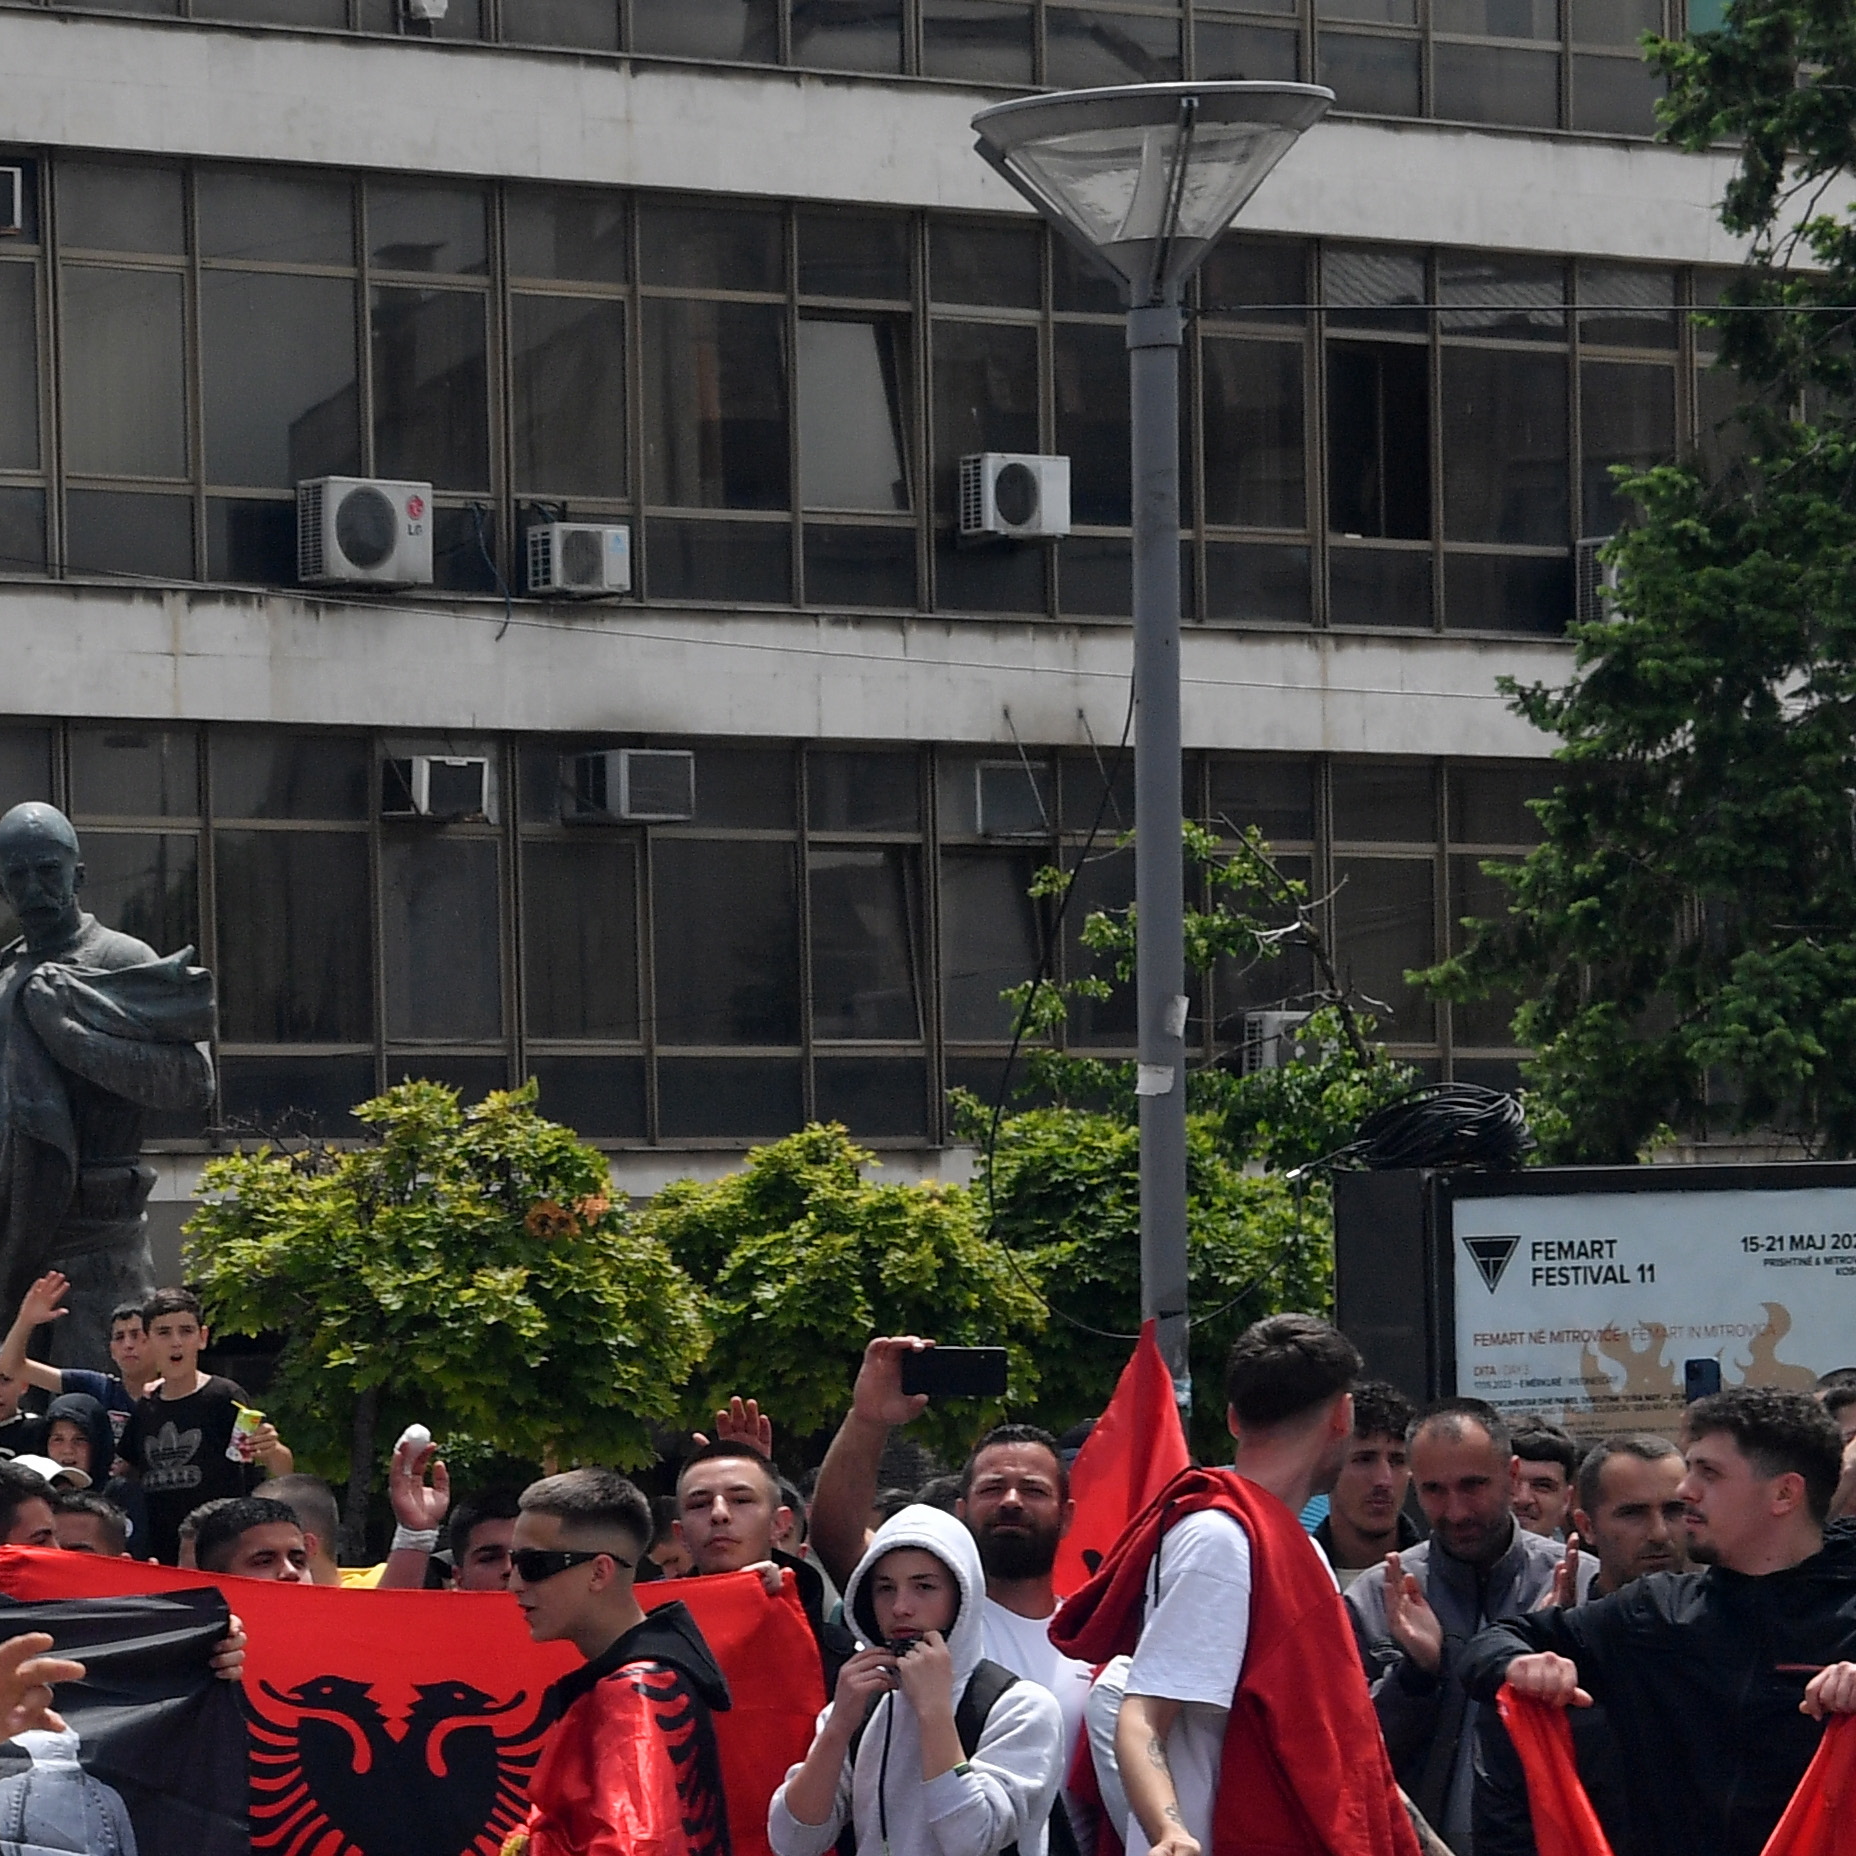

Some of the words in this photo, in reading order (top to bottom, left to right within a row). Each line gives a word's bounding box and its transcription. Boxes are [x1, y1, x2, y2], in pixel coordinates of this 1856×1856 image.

[1531, 1239, 1618, 1262] FEMART
[1741, 1235, 1785, 1253] 15-21
[1789, 1234, 1826, 1252] MAJ
[1531, 1264, 1631, 1287] FESTIVAL
[1637, 1263, 1656, 1284] 11
[1473, 1332, 1526, 1348] FEMART
